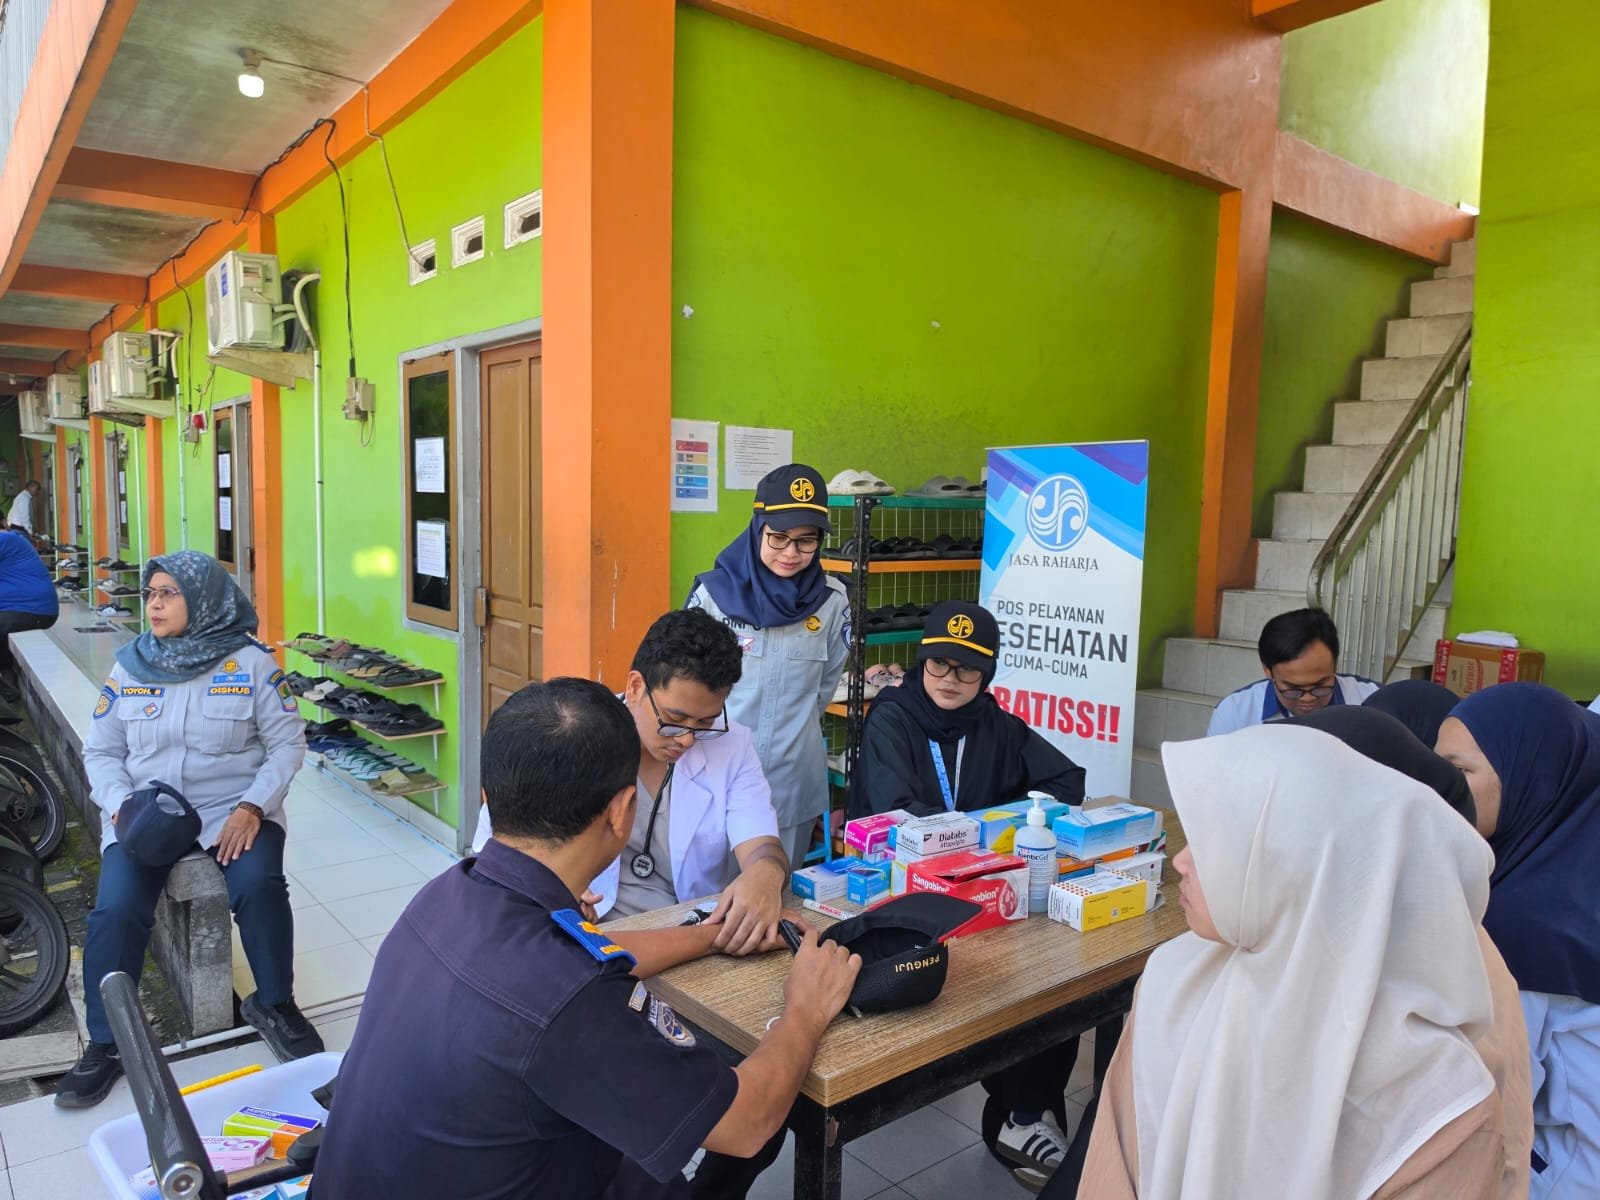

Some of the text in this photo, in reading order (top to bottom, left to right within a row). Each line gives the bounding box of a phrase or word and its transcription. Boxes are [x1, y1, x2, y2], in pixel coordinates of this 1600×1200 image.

[1008, 553, 1099, 572] JASA RAHARJA
[997, 600, 1105, 624] POS PELAYANAN
[996, 620, 1128, 663] ESEHATAN
[1004, 653, 1088, 679] CUMA-CUMA
[985, 686, 1121, 743] RATISS!!
[939, 830, 968, 843] Diatabs
[895, 953, 940, 973] PENGUJI
